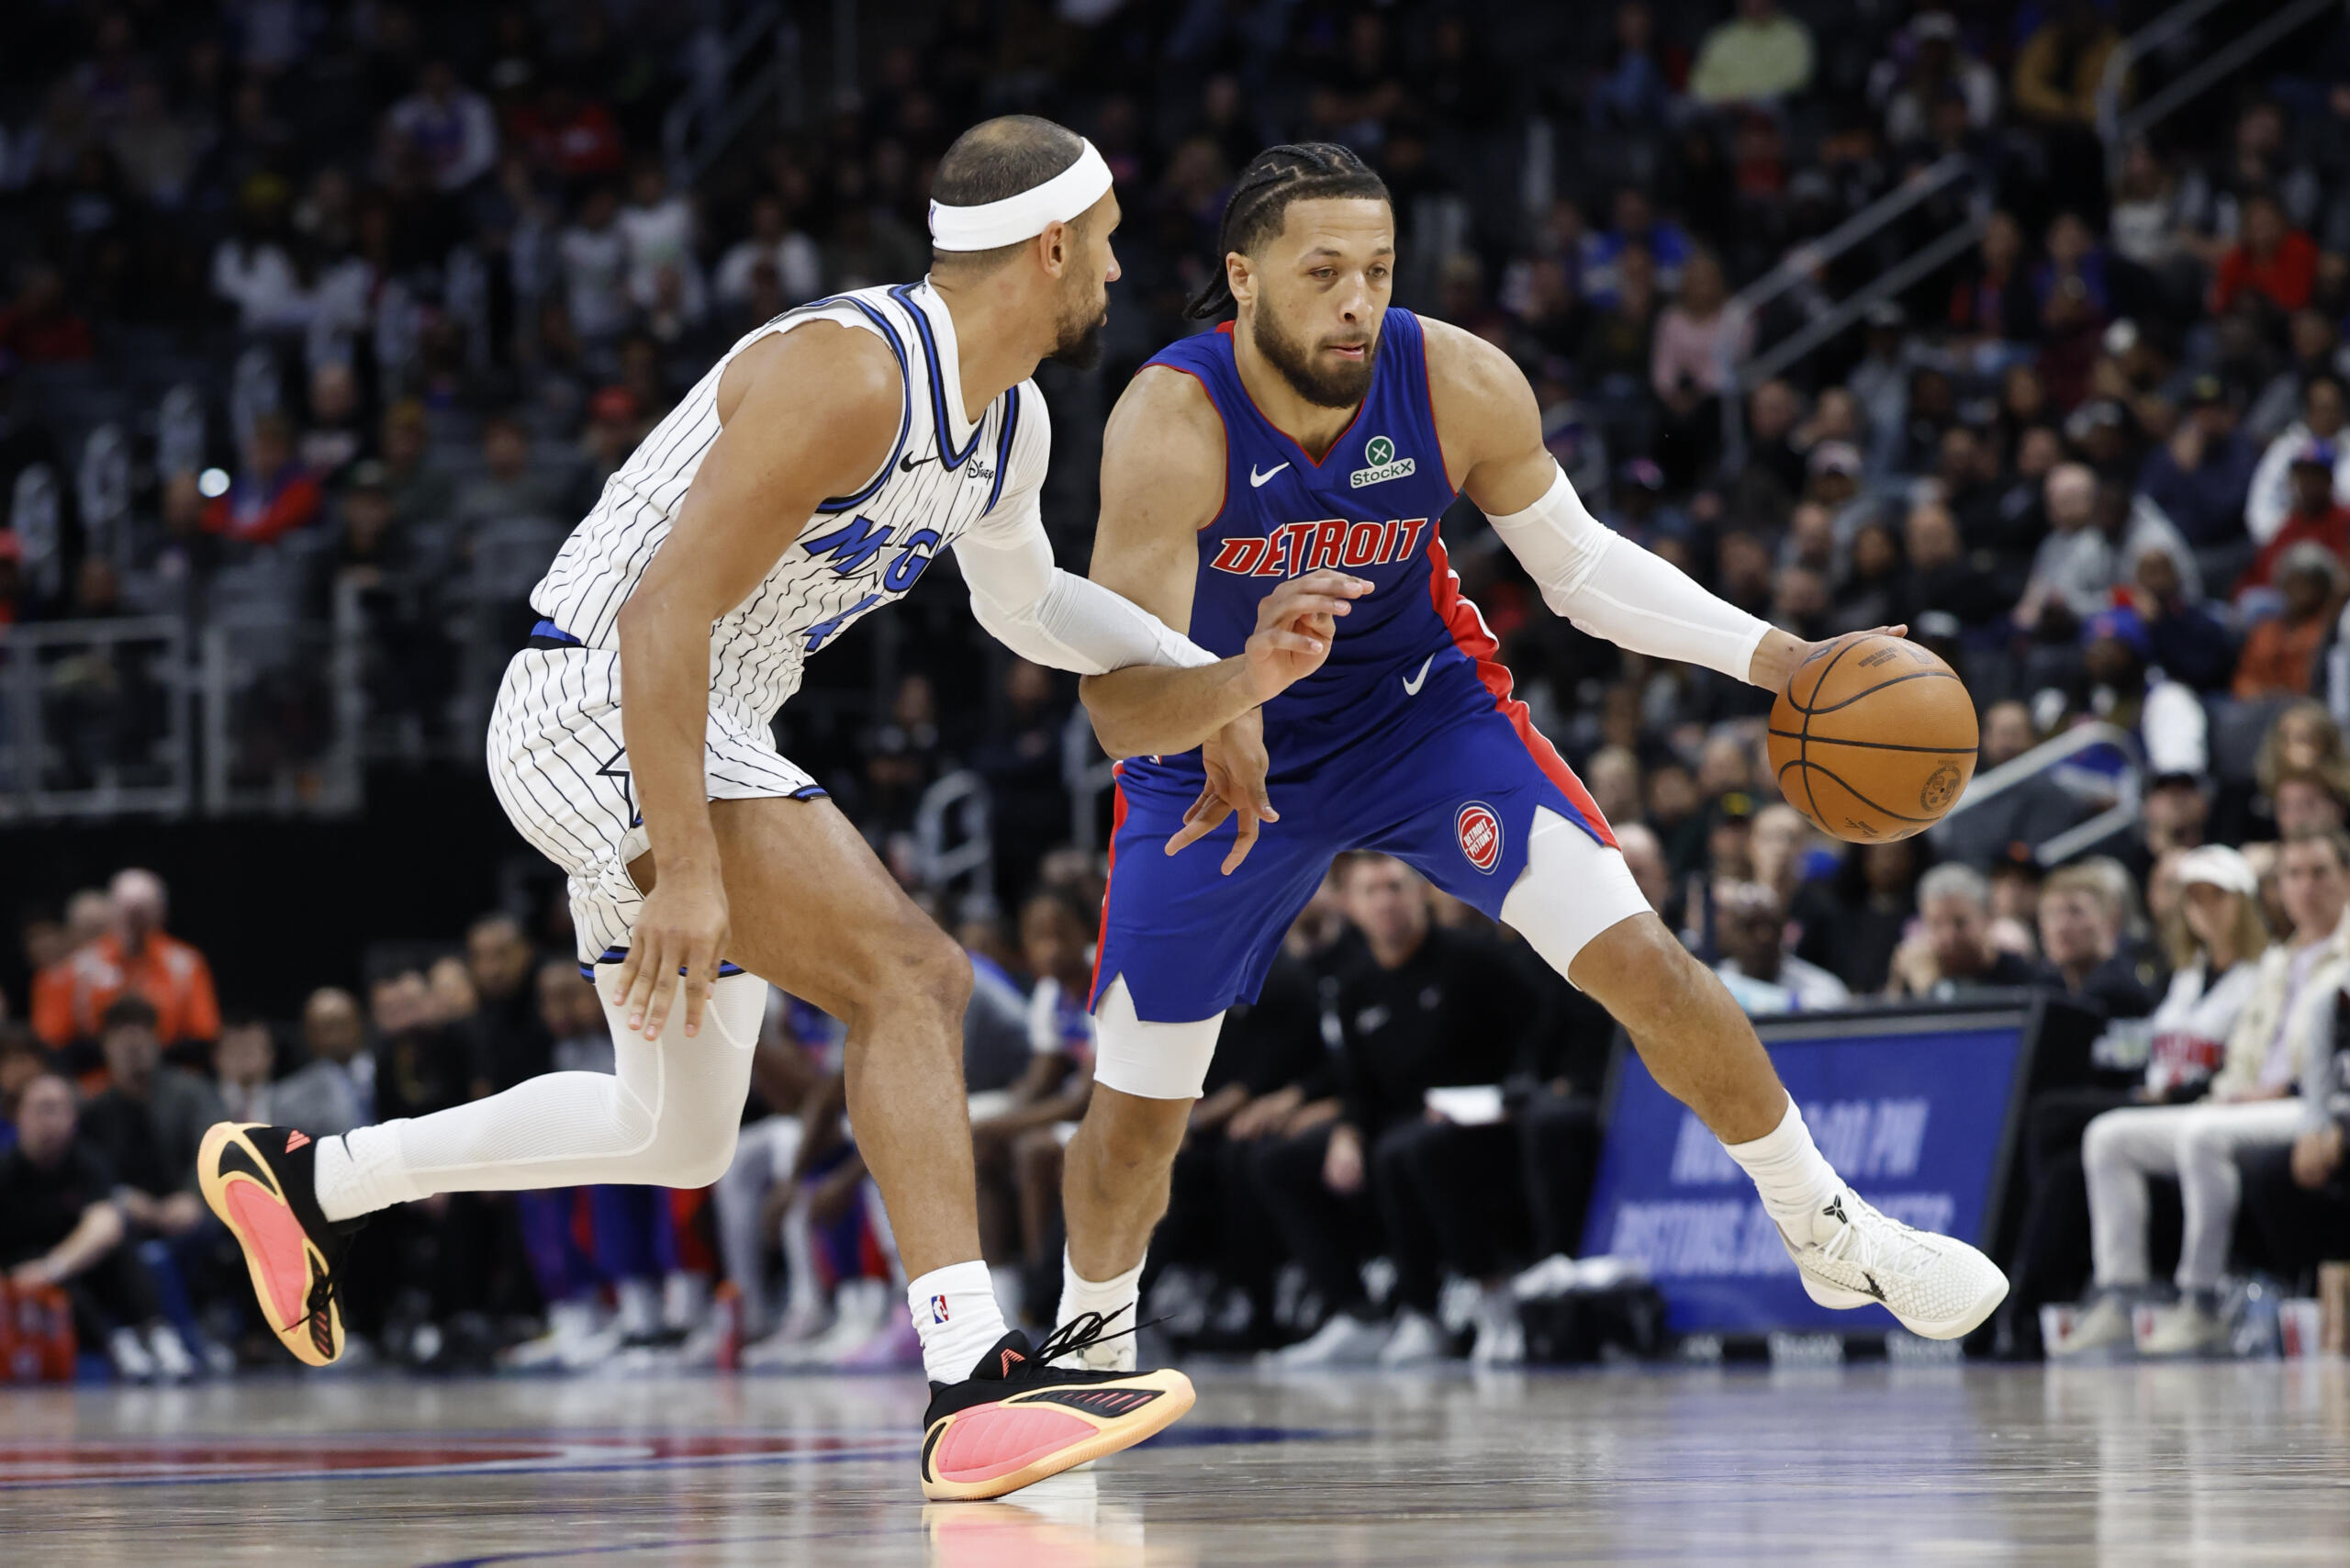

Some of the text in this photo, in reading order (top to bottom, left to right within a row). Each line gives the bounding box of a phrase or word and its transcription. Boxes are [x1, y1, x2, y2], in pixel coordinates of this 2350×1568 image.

[1352, 460, 1413, 486] StockX
[1210, 518, 1427, 579] DETROIT
[1463, 817, 1488, 846] DETROIT
[1469, 827, 1494, 857] PISTONS
